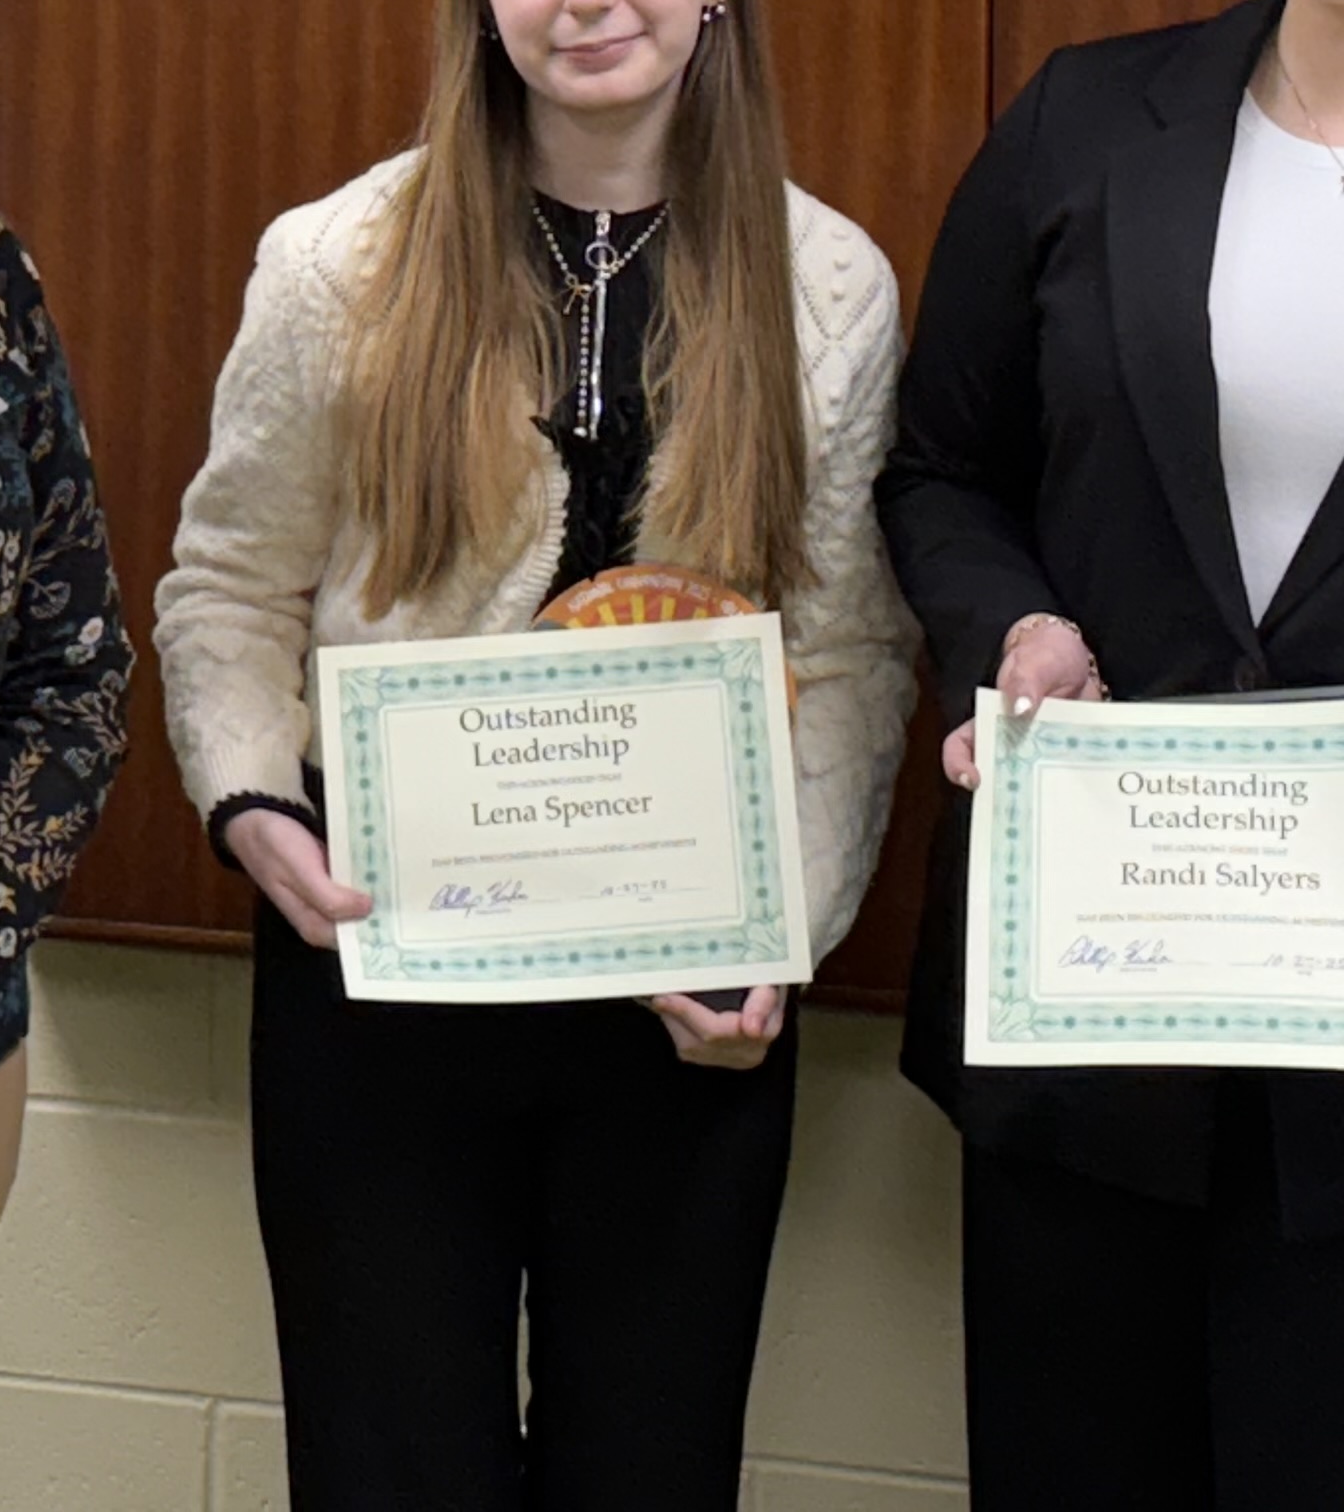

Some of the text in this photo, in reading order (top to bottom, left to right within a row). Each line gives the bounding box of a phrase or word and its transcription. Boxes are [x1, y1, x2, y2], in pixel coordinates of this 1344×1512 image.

[458, 699, 638, 733] Outstanding
[472, 734, 630, 767] Leadership
[1117, 770, 1309, 806] Outstanding
[471, 795, 654, 828] Lena Spencer
[1129, 804, 1299, 841] Leadership
[1121, 861, 1321, 896] Randi Salyers
